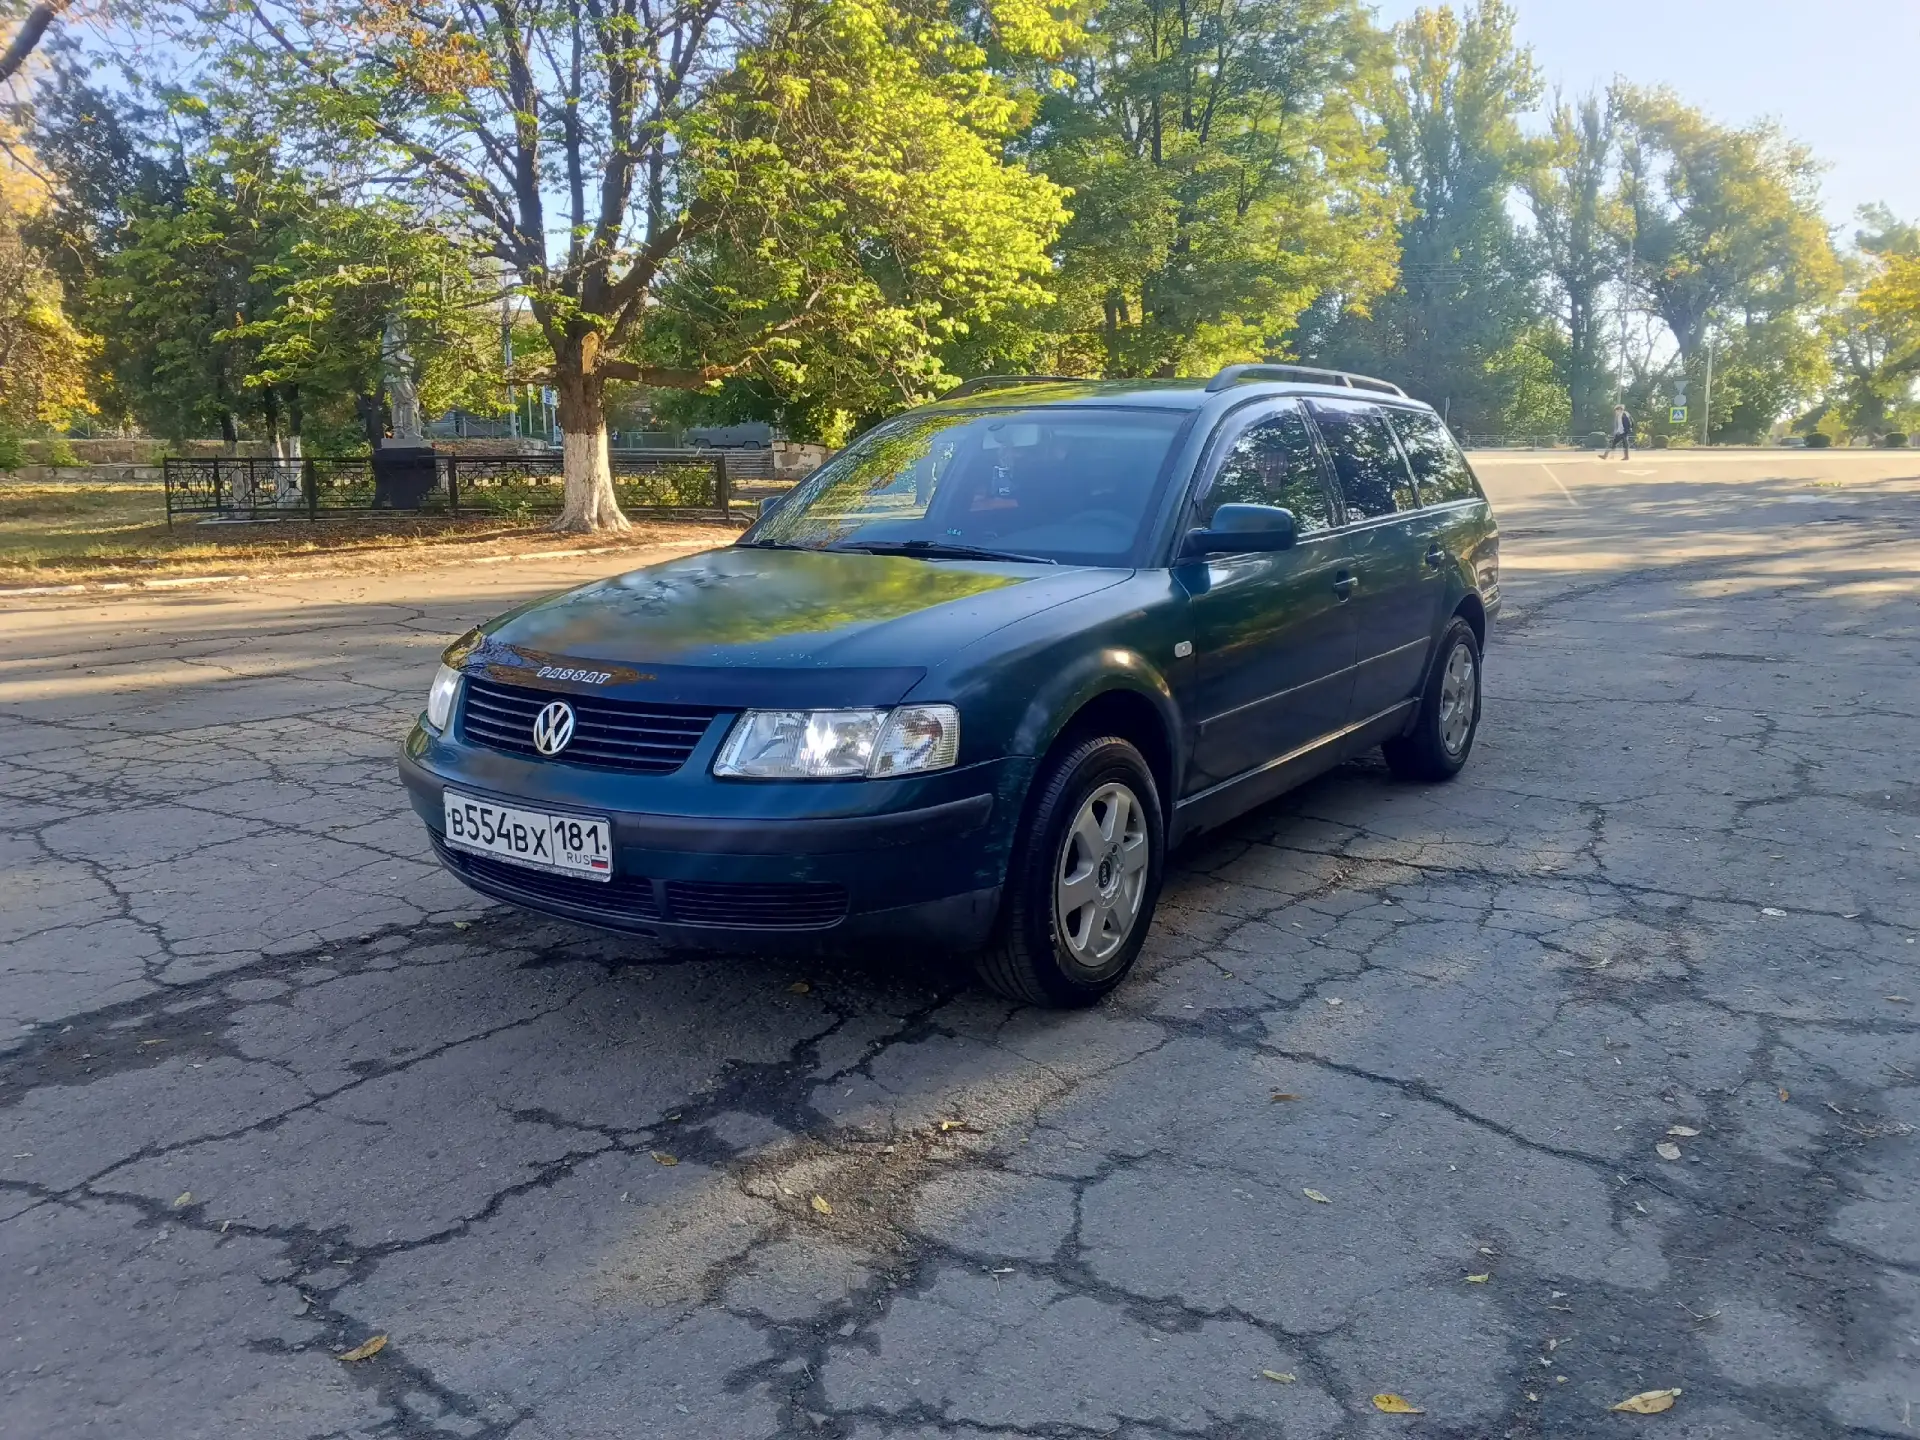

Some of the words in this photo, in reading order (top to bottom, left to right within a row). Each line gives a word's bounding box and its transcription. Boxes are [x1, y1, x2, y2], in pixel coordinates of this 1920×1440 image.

[536, 666, 611, 685] PASSAT
[554, 820, 600, 855] 181
[566, 851, 590, 866] RUS
